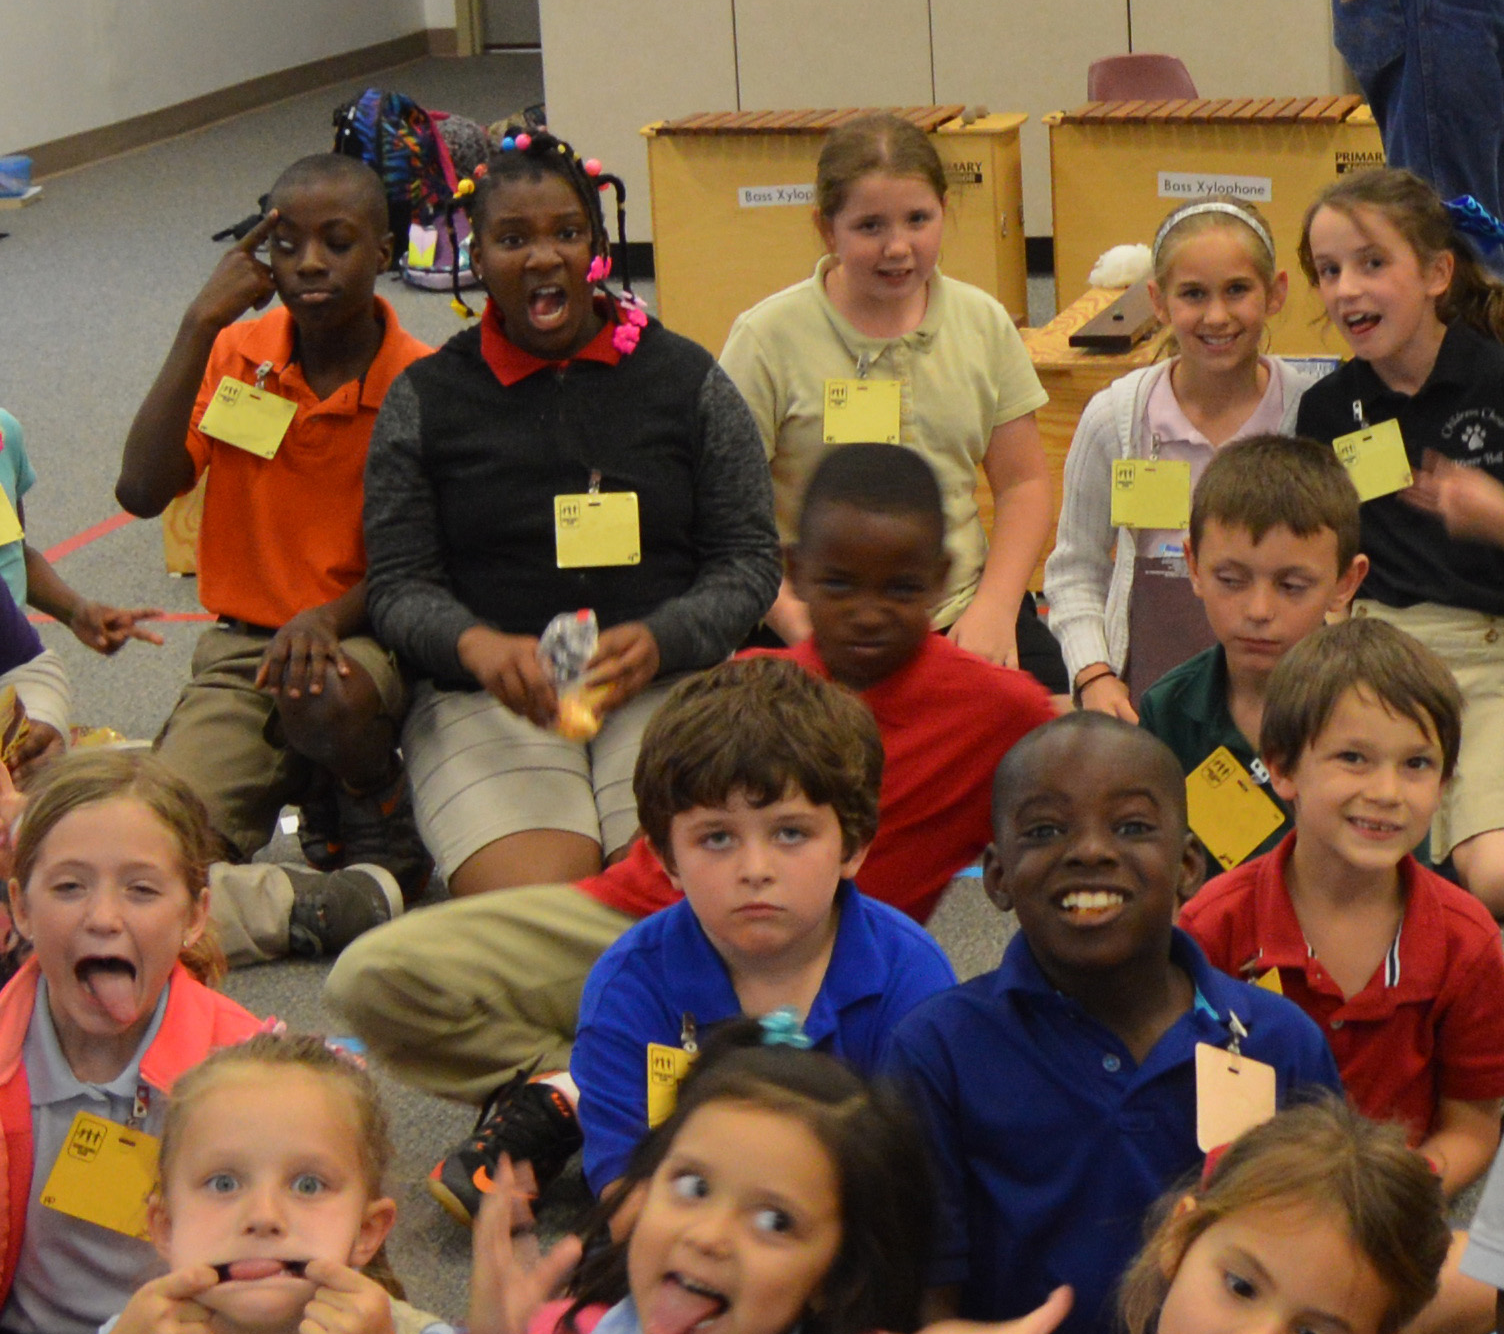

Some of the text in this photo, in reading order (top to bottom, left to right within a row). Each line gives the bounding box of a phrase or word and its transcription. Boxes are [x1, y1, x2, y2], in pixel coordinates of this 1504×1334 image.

[1335, 151, 1384, 162] PRIMAR
[745, 188, 813, 203] Bass Xylop
[1164, 179, 1265, 197] Bass Xylophone
